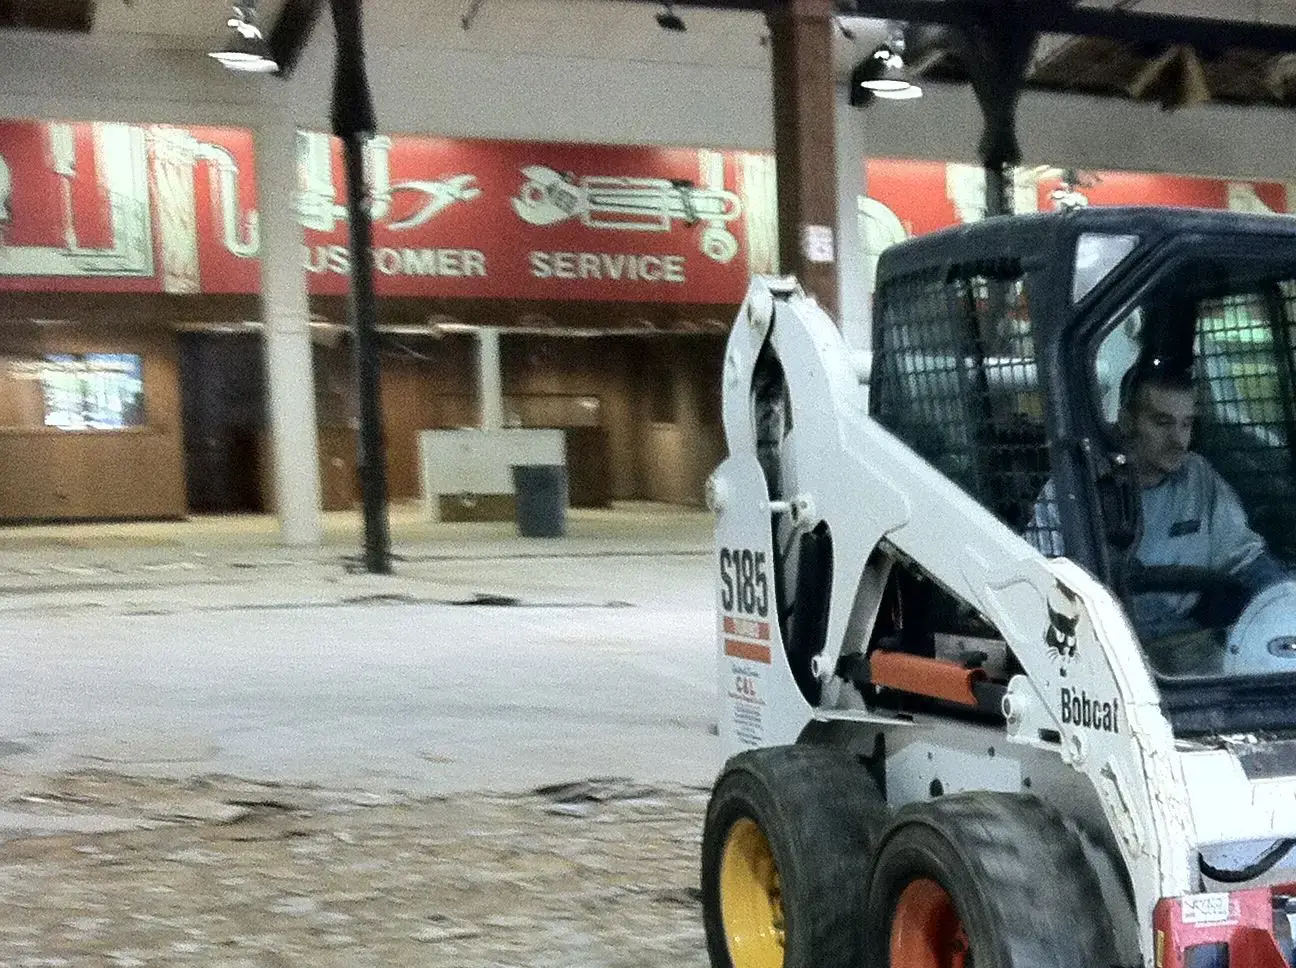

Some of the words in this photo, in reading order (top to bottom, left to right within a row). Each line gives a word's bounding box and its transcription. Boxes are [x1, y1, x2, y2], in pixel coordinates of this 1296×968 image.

[302, 246, 487, 276] USOMER
[530, 250, 687, 283] SERVICE
[720, 547, 769, 618] S185
[1061, 687, 1119, 734] Bobcat
